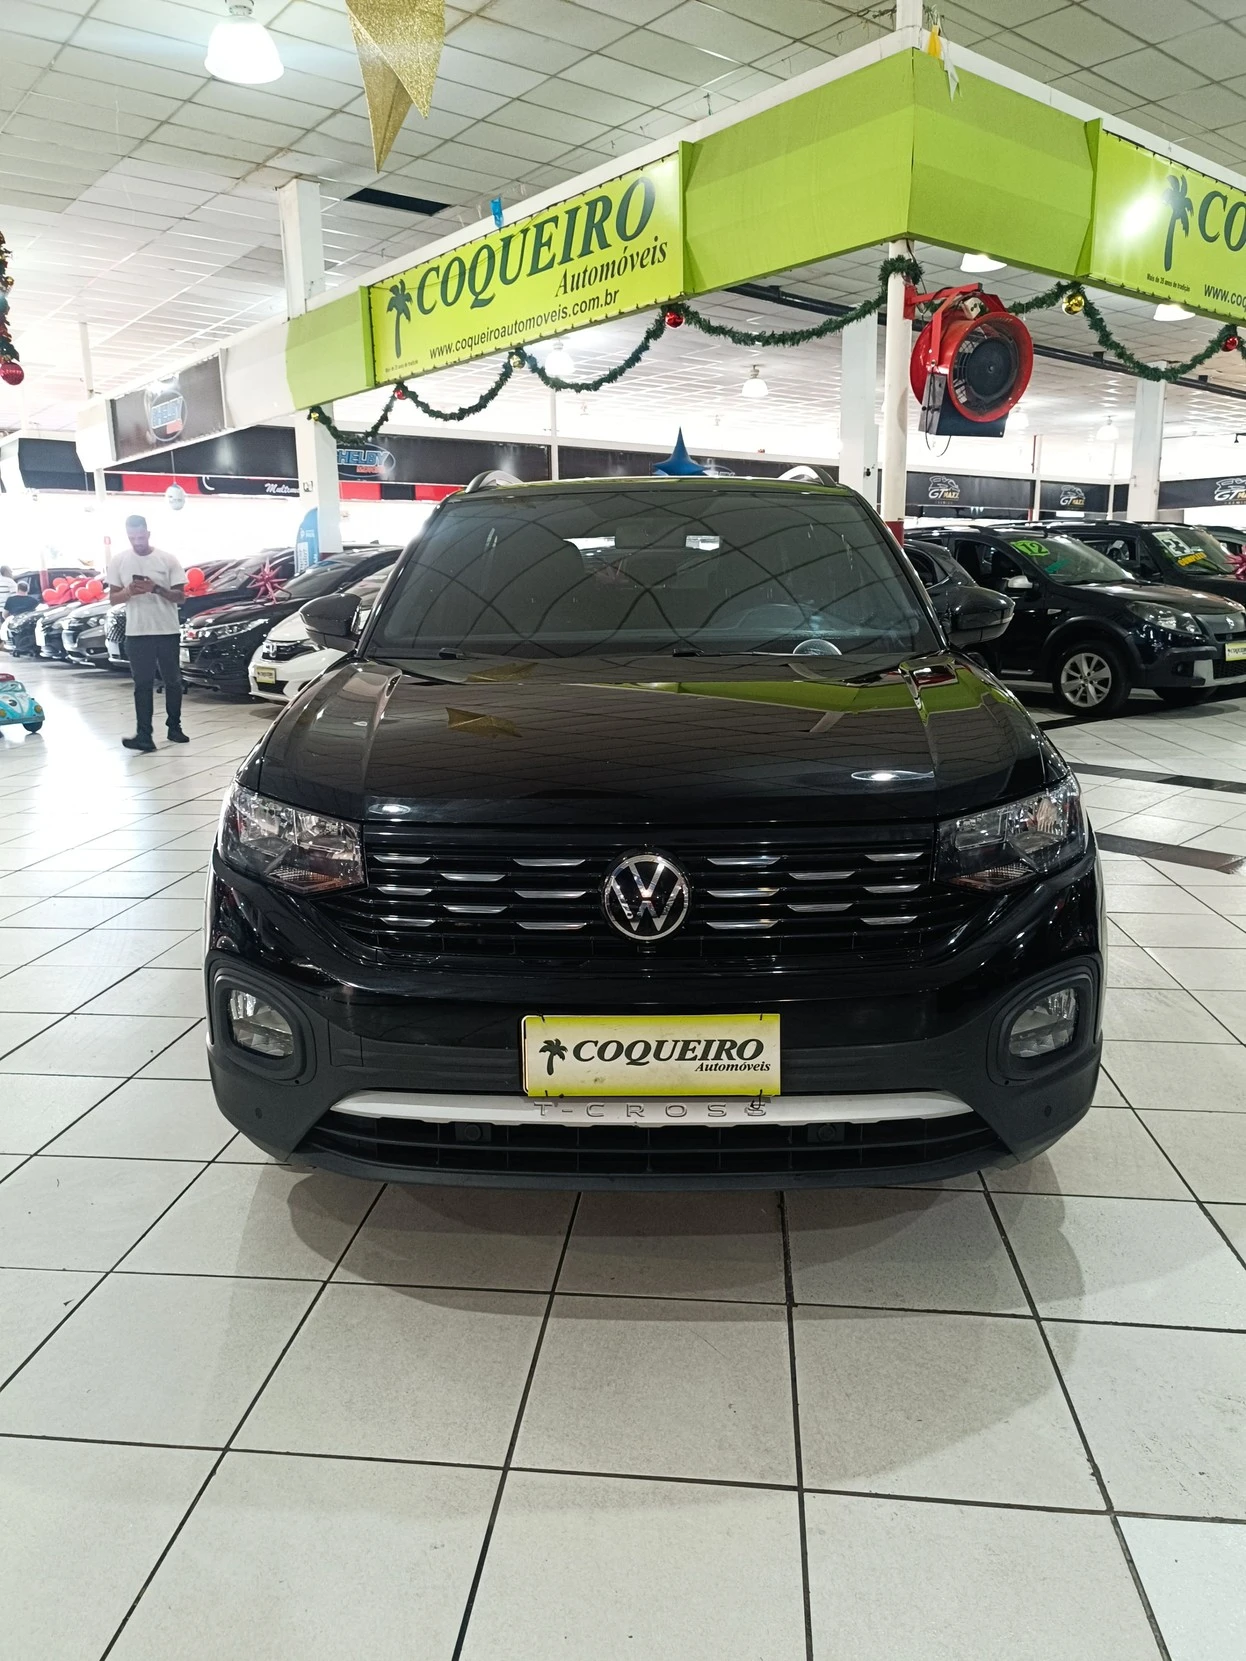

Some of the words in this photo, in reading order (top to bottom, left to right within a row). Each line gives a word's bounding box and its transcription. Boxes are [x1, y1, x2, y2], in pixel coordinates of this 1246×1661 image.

[416, 176, 656, 315] COQUEIRO
[554, 235, 668, 298] Automóveis
[429, 288, 620, 360] www.coqueiroautomoveis.com.br
[337, 449, 390, 467] HELBY
[1018, 542, 1049, 555] 12
[572, 1038, 764, 1066] COQUEIRO
[694, 1060, 771, 1073] Automóveis
[533, 1101, 767, 1118] T-CROSS
